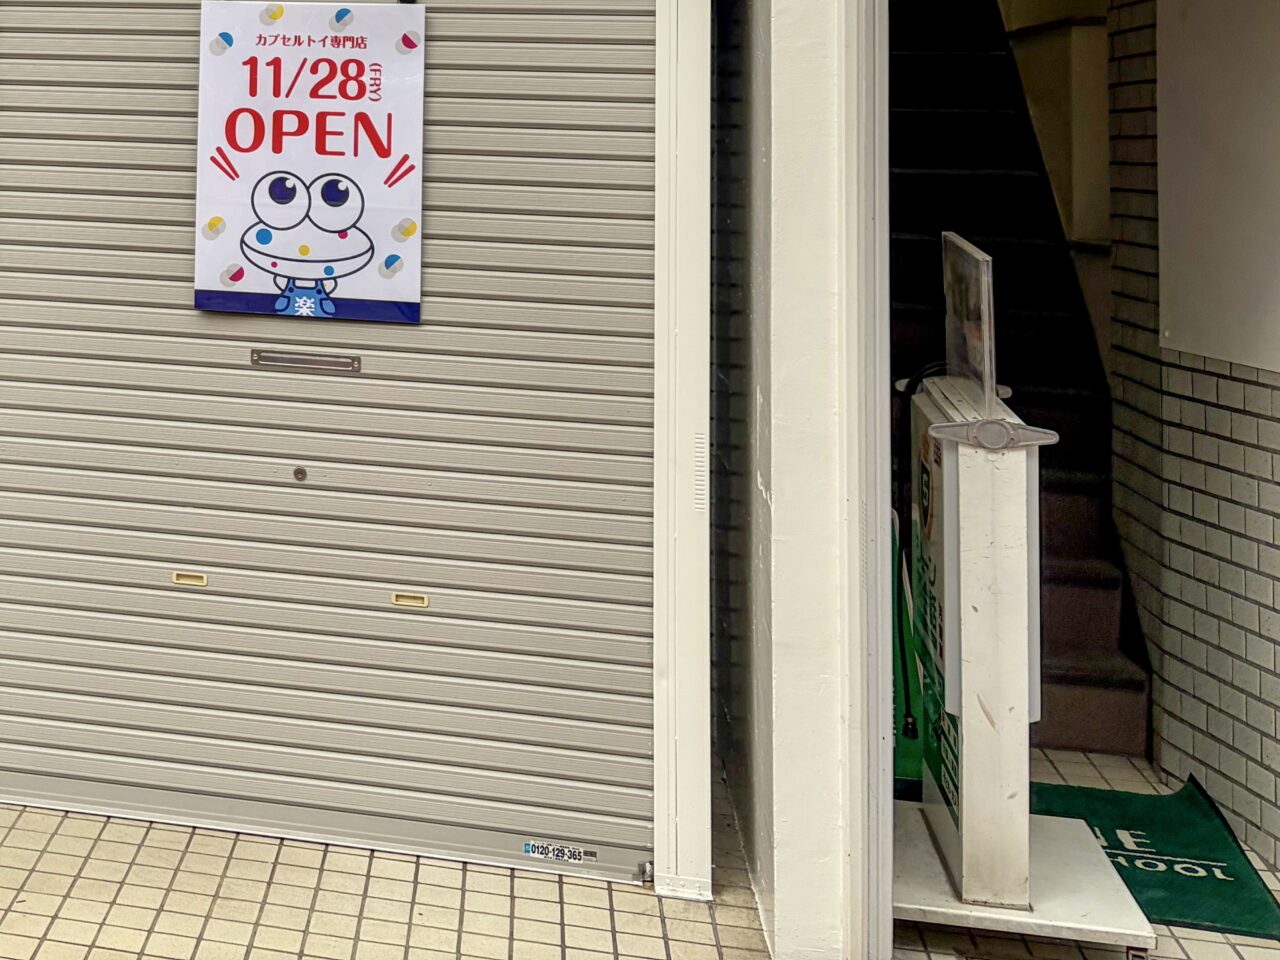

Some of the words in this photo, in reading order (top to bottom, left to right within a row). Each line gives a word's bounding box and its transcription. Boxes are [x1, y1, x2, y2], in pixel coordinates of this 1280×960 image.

[255, 33, 368, 50] カプセルトイ専門店
[242, 56, 367, 101] 11/28
[367, 62, 383, 102] (FRY)
[224, 107, 393, 159] OPEN
[294, 296, 315, 317] 楽
[531, 844, 583, 861] 0120-129-365
